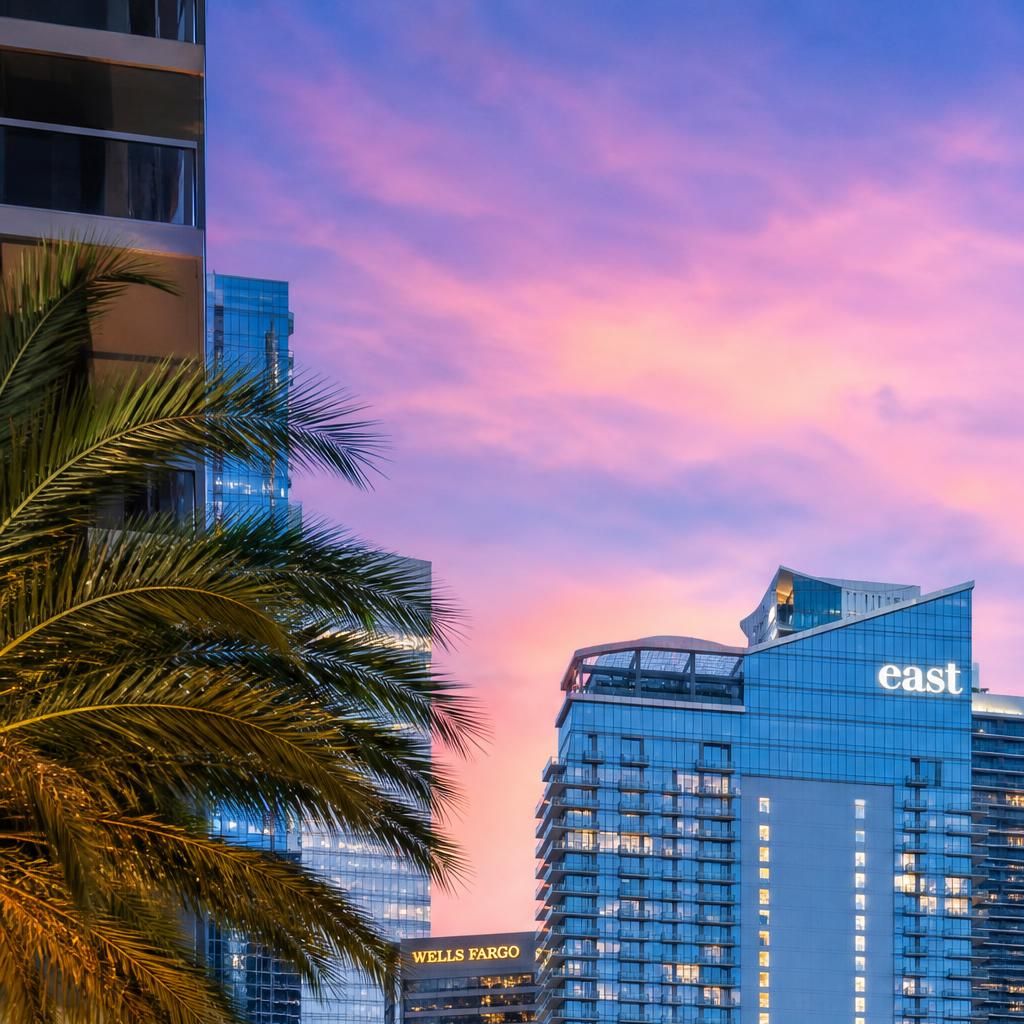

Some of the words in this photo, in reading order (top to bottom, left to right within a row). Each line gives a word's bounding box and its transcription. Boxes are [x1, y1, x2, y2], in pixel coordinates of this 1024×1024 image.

[878, 663, 964, 695] east
[411, 949, 465, 964] WELLS
[468, 945, 520, 961] FARGO
